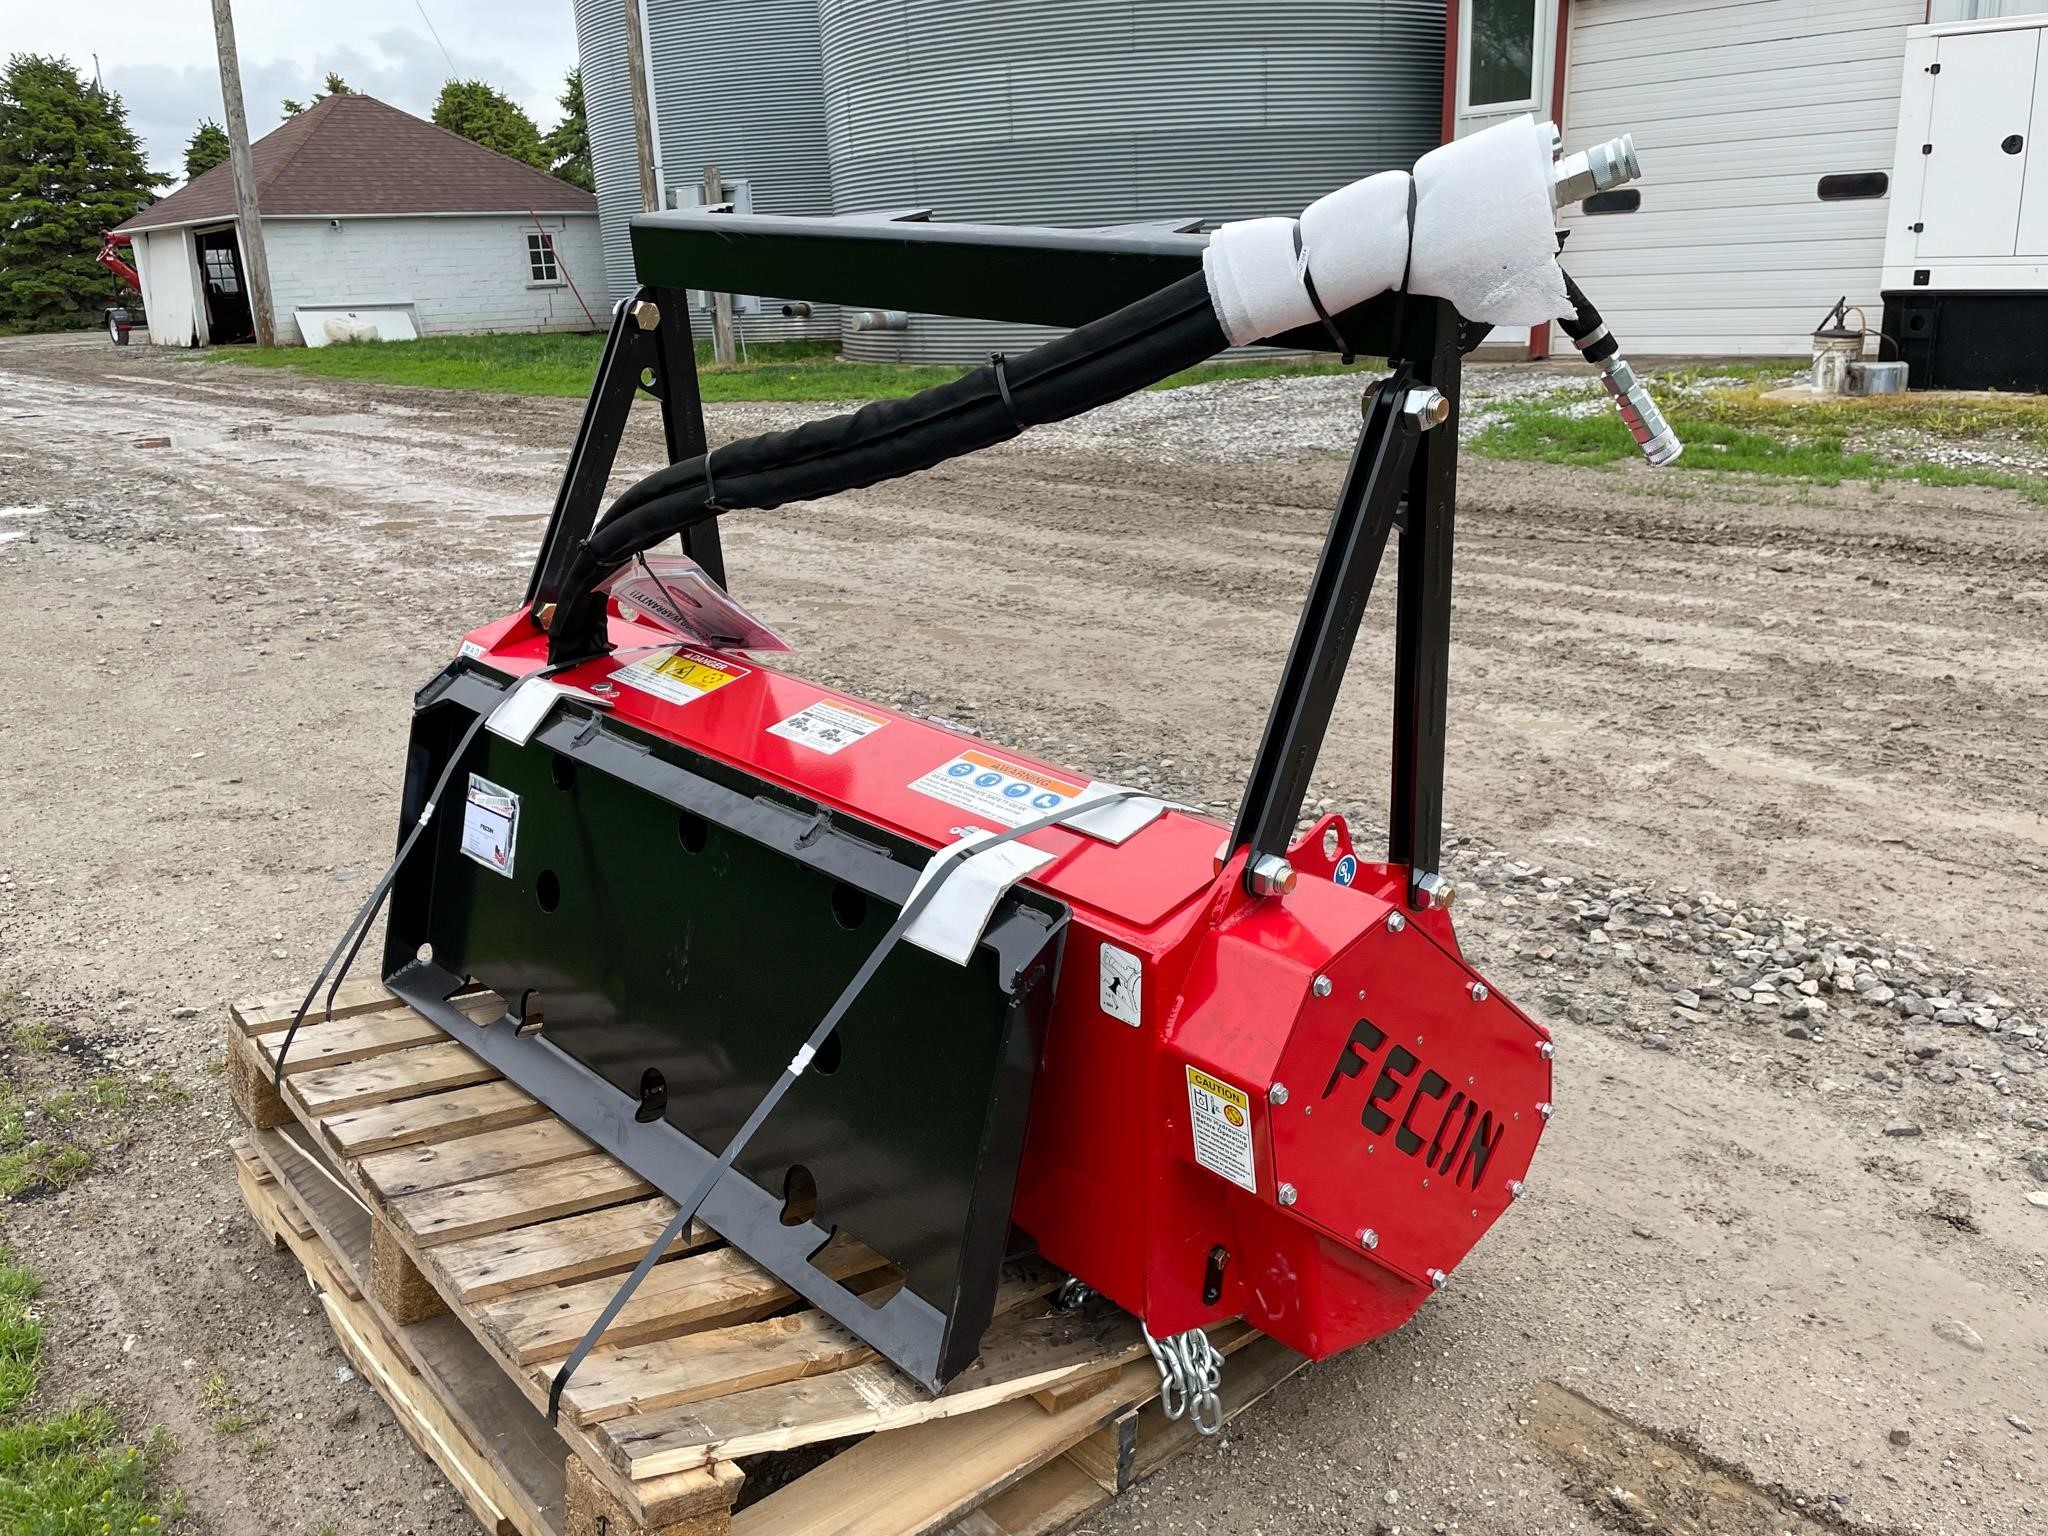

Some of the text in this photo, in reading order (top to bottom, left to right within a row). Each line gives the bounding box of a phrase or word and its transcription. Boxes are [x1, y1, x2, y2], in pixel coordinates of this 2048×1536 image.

[688, 654, 729, 670] DANGER
[995, 764, 1053, 787] WARNING
[946, 779, 987, 796] APPROPRIATE
[984, 793, 1010, 805] SAFETY
[1007, 802, 1028, 811] GEAR
[1194, 1073, 1240, 1104] CAUTION
[1321, 1017, 1504, 1192] FECON
[1194, 1110, 1247, 1141] Warm Hydraulics
[1195, 1116, 1247, 1148] Before Operating
